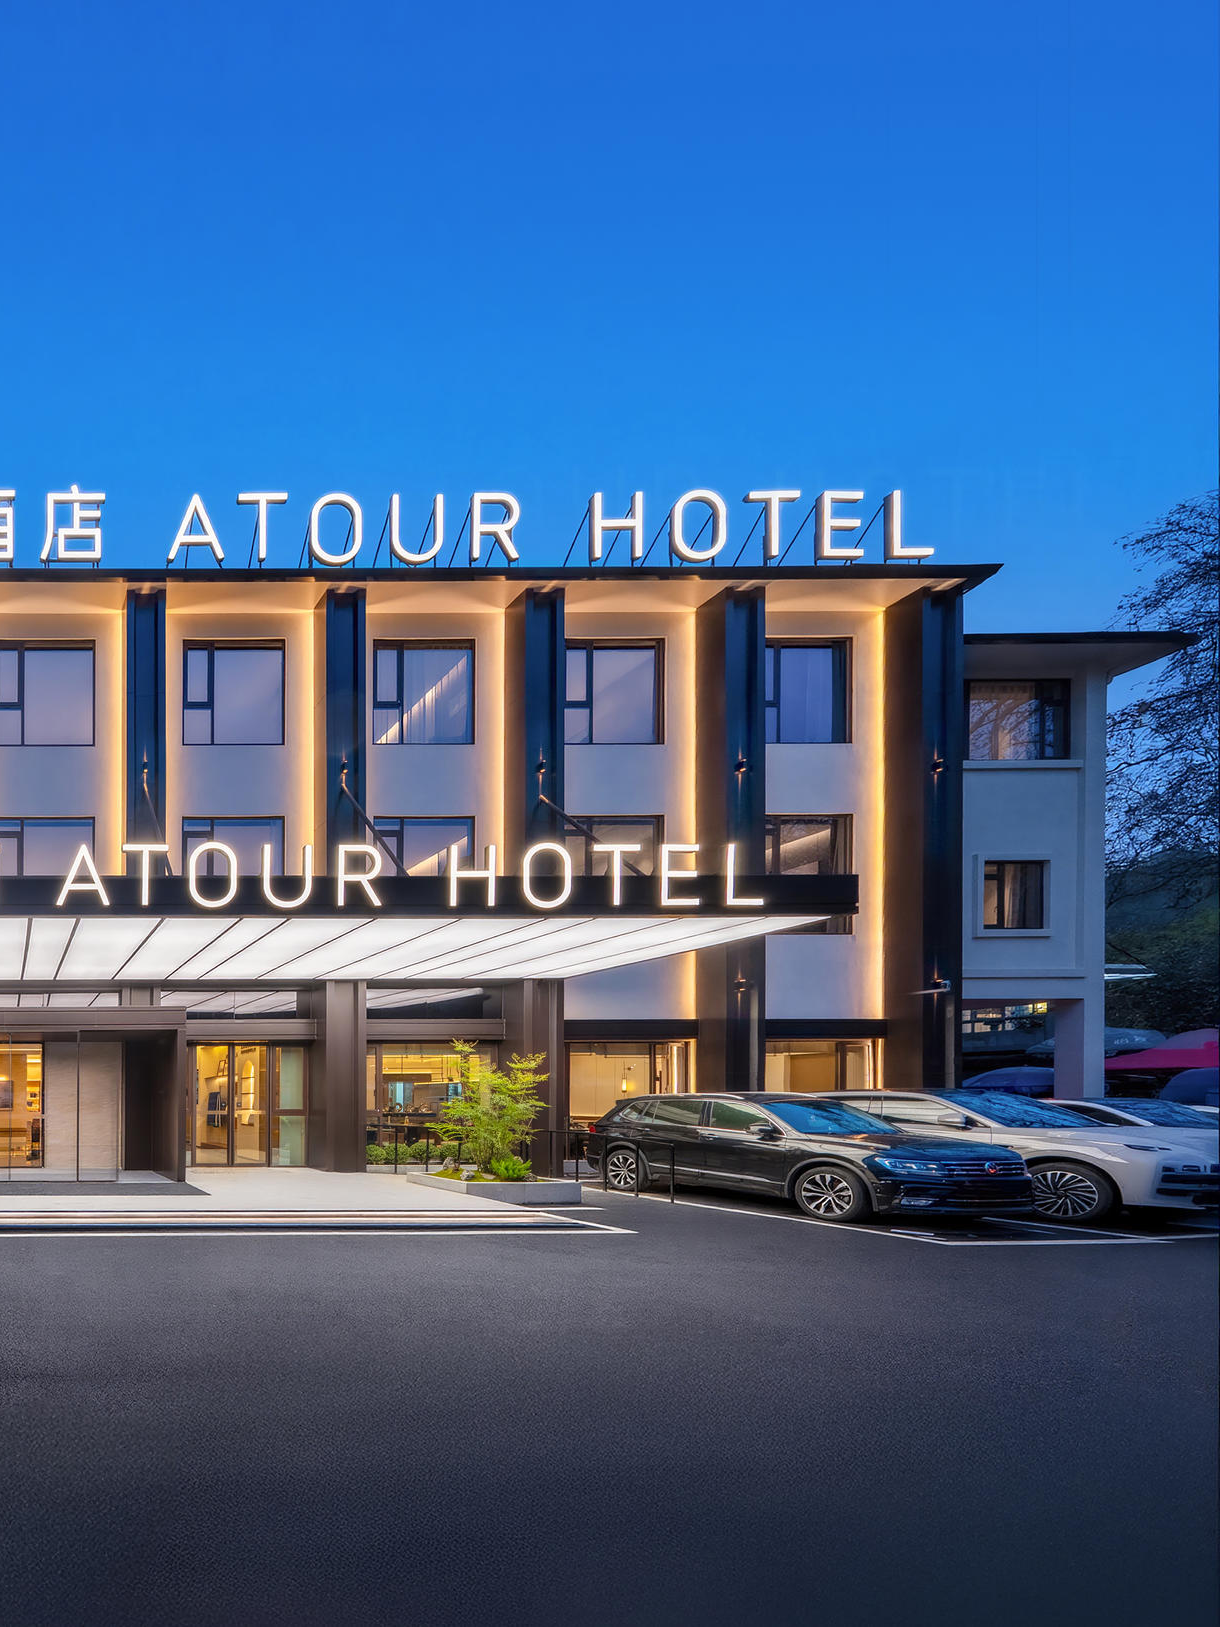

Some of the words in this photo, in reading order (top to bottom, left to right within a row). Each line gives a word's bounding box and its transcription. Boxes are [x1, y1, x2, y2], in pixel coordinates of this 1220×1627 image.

[167, 491, 522, 563] ATOUR
[592, 489, 936, 561] HOTEL
[54, 842, 384, 908] ATOUR
[448, 842, 766, 908] HOTEL
